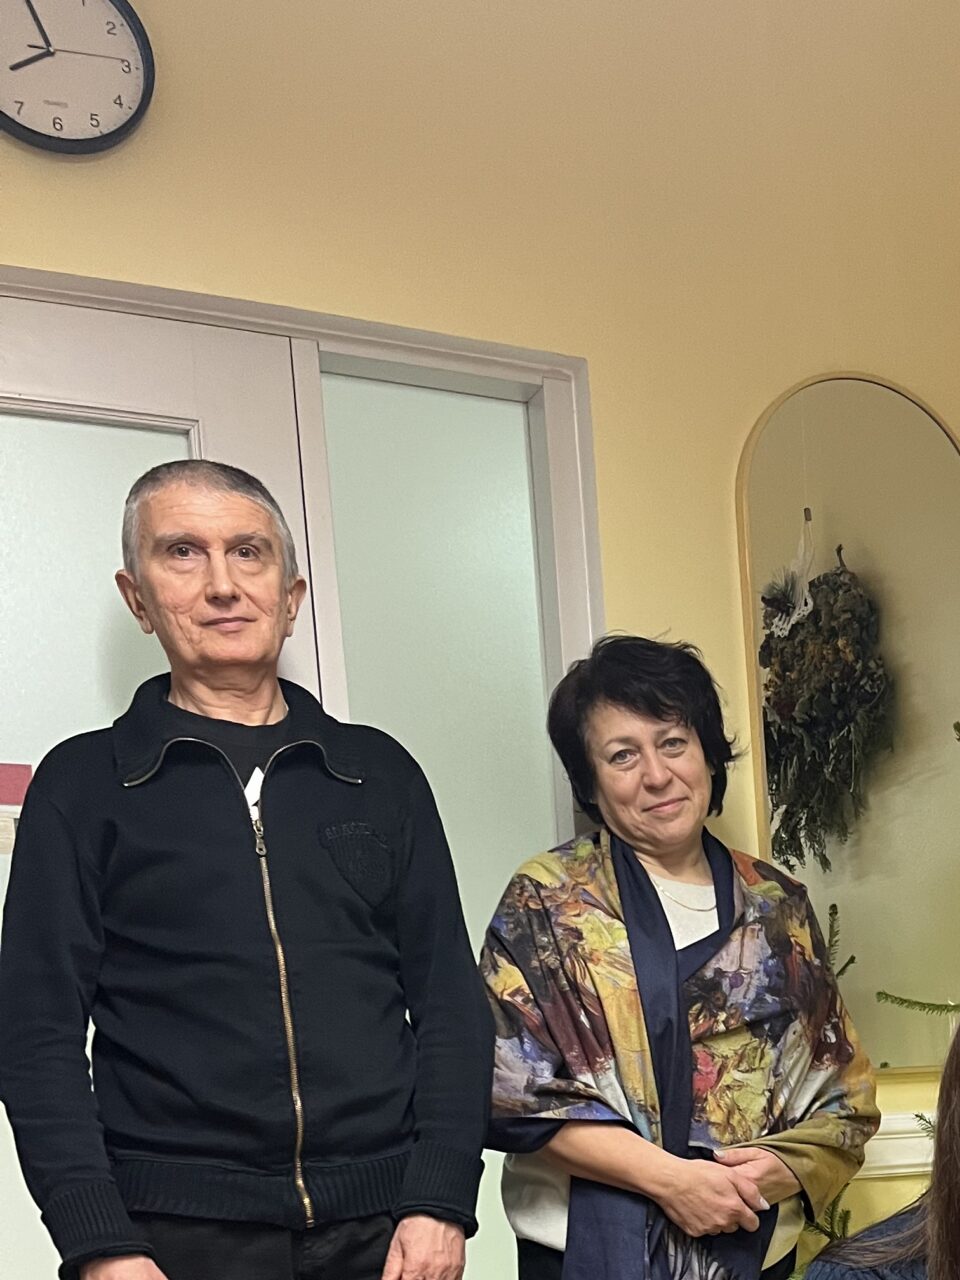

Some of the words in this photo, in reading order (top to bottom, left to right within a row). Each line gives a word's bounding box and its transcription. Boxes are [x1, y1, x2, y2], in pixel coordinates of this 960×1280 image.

[105, 20, 118, 36] 2
[120, 59, 132, 74] 3
[14, 100, 24, 116] 7
[113, 94, 124, 109] 4
[52, 116, 63, 132] 6
[90, 113, 100, 128] 5
